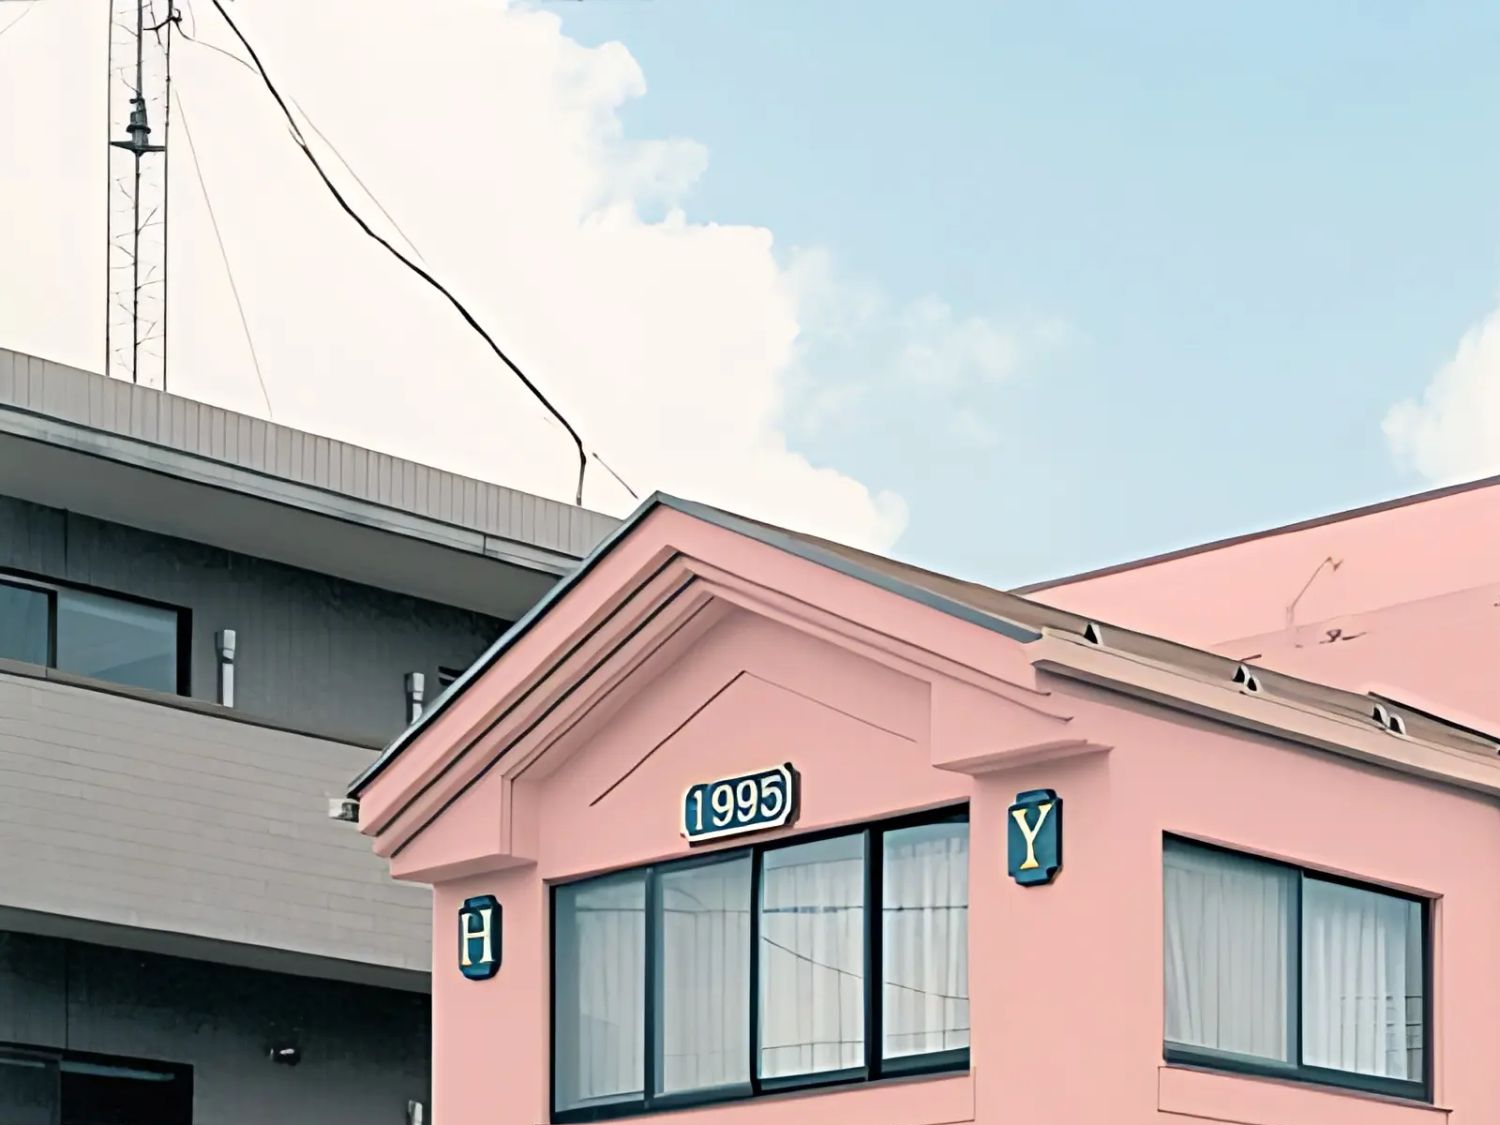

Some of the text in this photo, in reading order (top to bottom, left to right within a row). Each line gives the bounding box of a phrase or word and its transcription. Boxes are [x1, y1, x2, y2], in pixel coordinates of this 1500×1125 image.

[694, 774, 783, 830] 1995
[1011, 803, 1053, 870] Y
[461, 908, 494, 966] H
